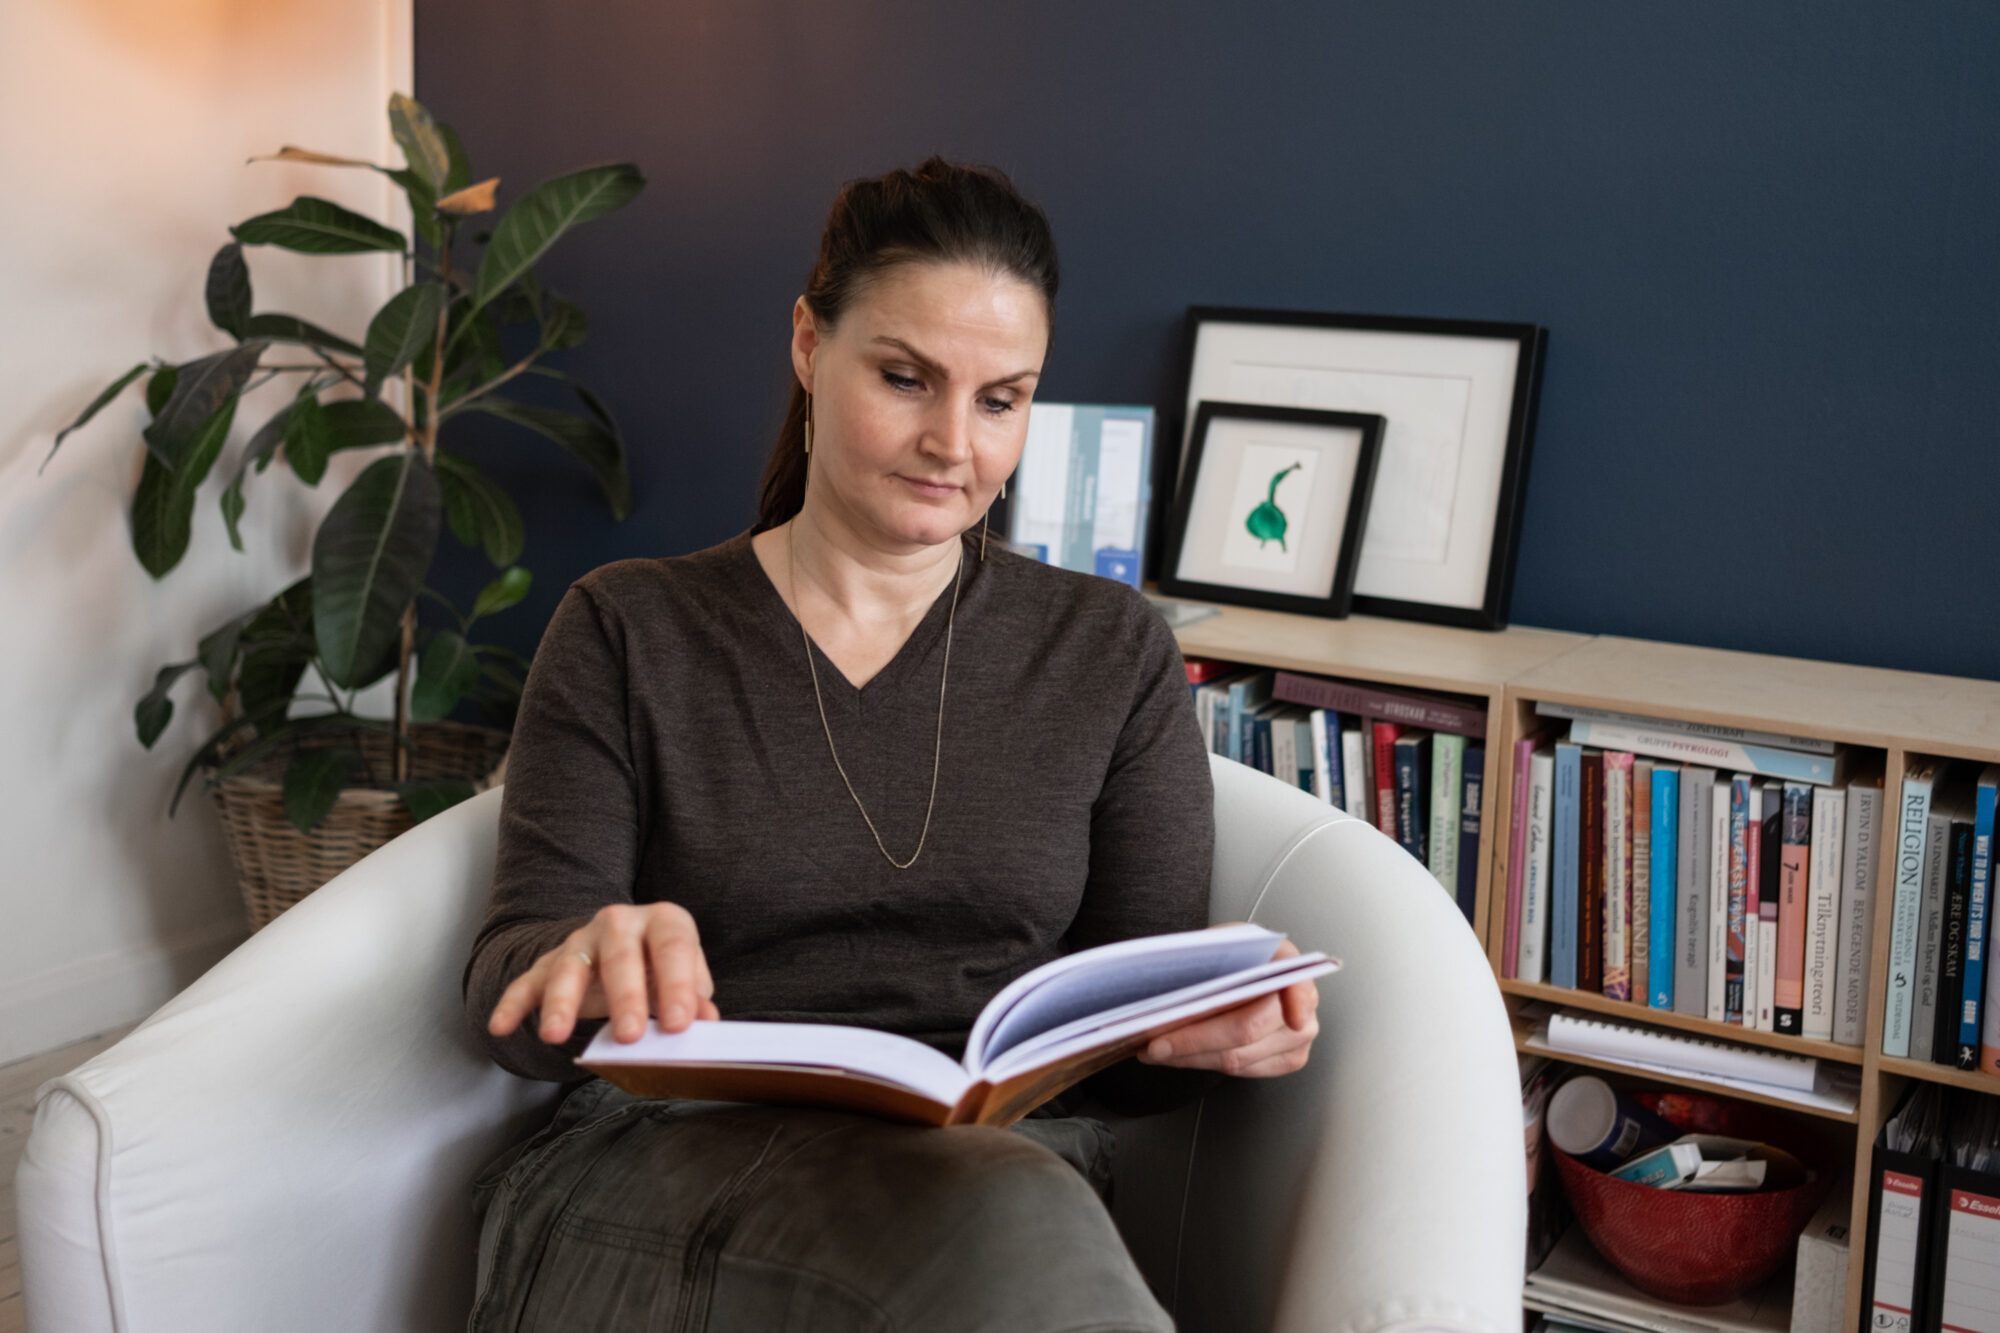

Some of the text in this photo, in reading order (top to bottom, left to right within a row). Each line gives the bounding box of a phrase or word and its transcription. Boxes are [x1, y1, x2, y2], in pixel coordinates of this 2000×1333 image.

[1636, 734, 1730, 760] GRUPPEPSYKOLOGI
[1859, 793, 1873, 830] IRVIN
[1612, 819, 1621, 834] Det
[1933, 825, 1944, 843] JAN
[1900, 794, 1925, 888] RELIGION
[1976, 834, 1990, 857] WHAT
[1730, 811, 1745, 934] NETVÆRKSSTYRING
[1783, 861, 1800, 872] 7
[1854, 846, 1868, 891] YALOM
[1929, 845, 1943, 903] LINDHARDT
[1973, 869, 1987, 880] DO
[1974, 858, 1988, 868] TO
[1632, 838, 1650, 969] HILDEBRANDT
[1909, 890, 1917, 902] EN
[1950, 891, 1963, 919] ÆRE
[1972, 882, 1986, 903] WHEN
[1686, 893, 1700, 936] Kognitiv
[1970, 904, 1984, 919] IT'S
[1848, 899, 1864, 975] BEVÆGENDE
[1894, 890, 1907, 967] LIVSANSKUELSER
[1904, 904, 1916, 958] GRUNDBOG
[1947, 920, 1959, 941] OG
[1969, 920, 1983, 939] YOUR
[1685, 937, 1698, 969] terapi
[1809, 892, 1833, 1017] Tilknytningsteori
[1945, 942, 1959, 977] SKAM
[1967, 940, 1981, 961] TURN
